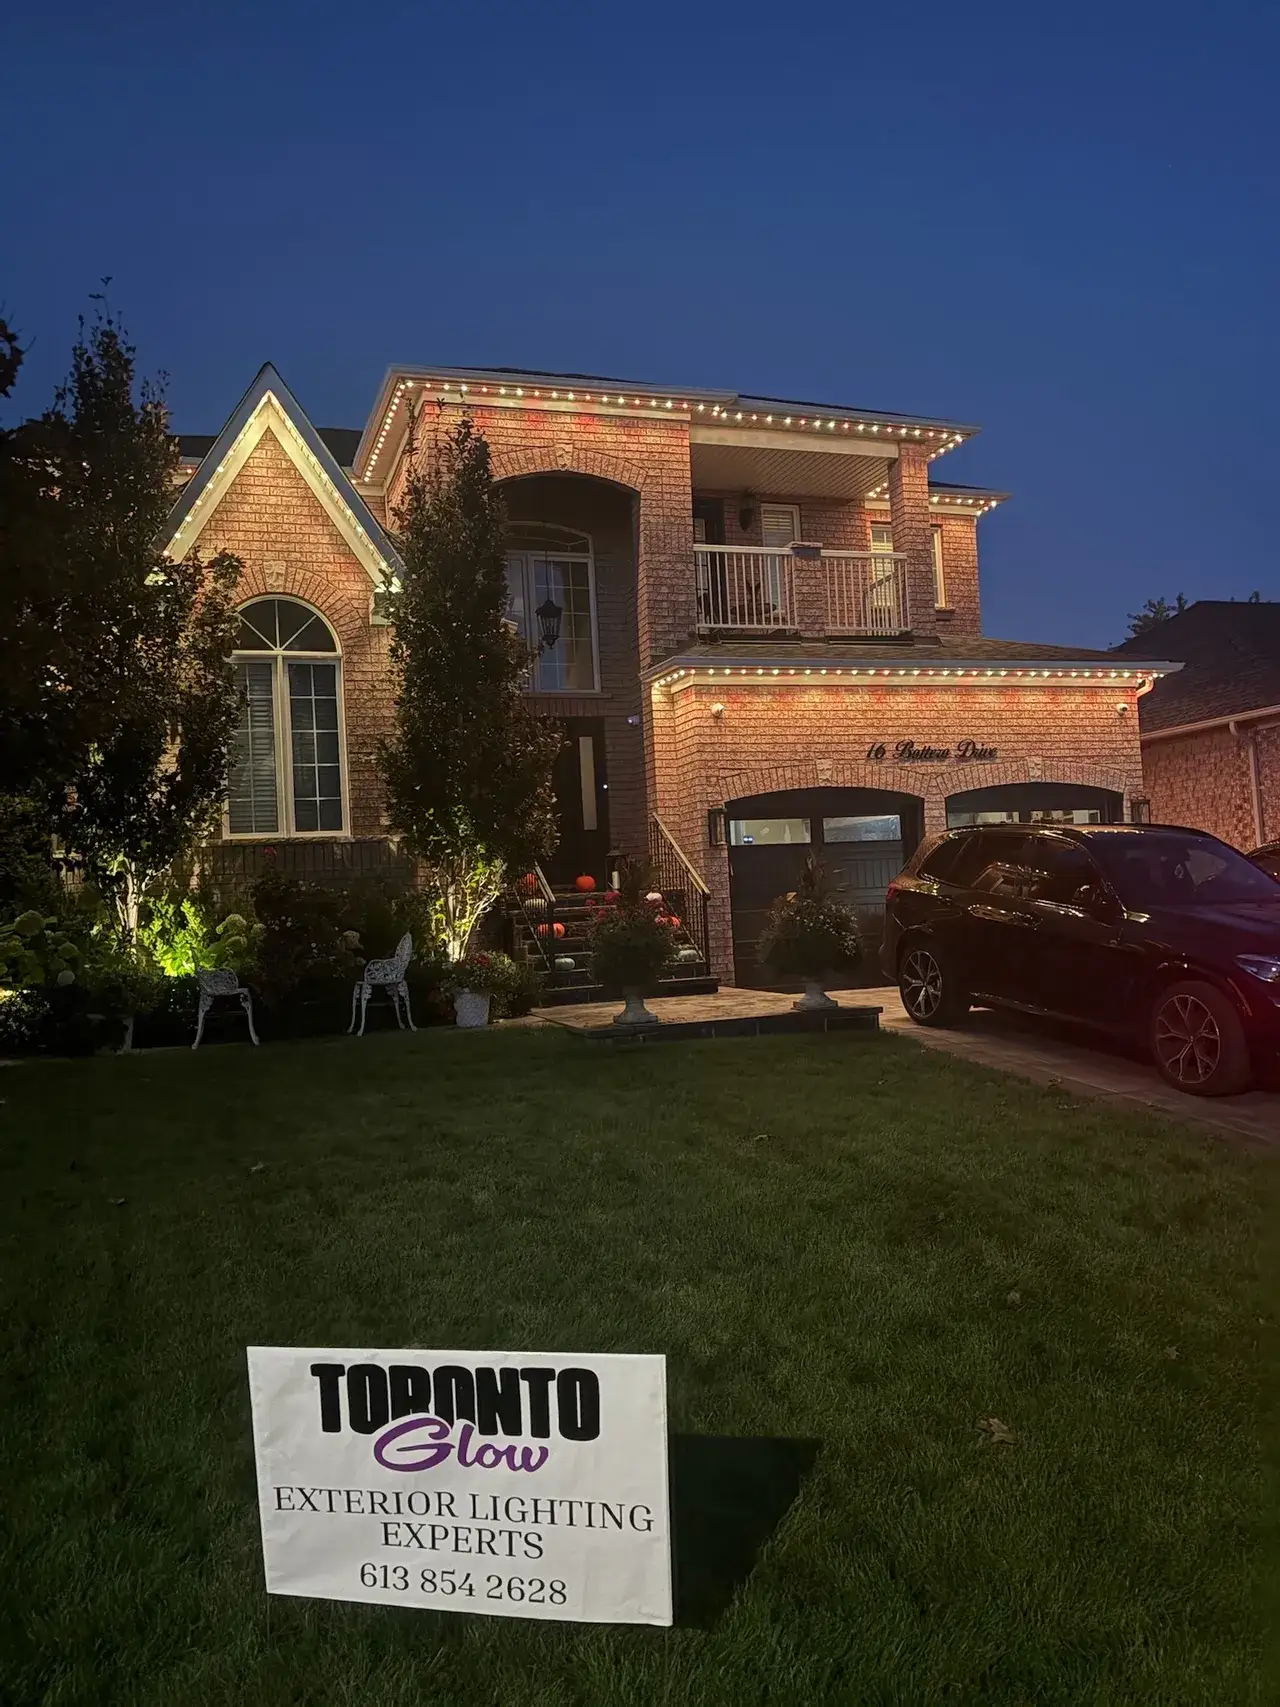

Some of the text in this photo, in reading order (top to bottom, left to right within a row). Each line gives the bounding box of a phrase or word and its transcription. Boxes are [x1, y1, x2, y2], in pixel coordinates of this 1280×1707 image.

[866, 742, 887, 760] 16
[955, 739, 998, 759] Drive
[310, 1363, 600, 1442] TORONTO
[373, 1416, 549, 1473] Glow
[273, 1486, 655, 1532] EXTERIOR LIGHTING
[381, 1522, 544, 1560] EXPERTS
[359, 1562, 568, 1605] 613 854 2628
